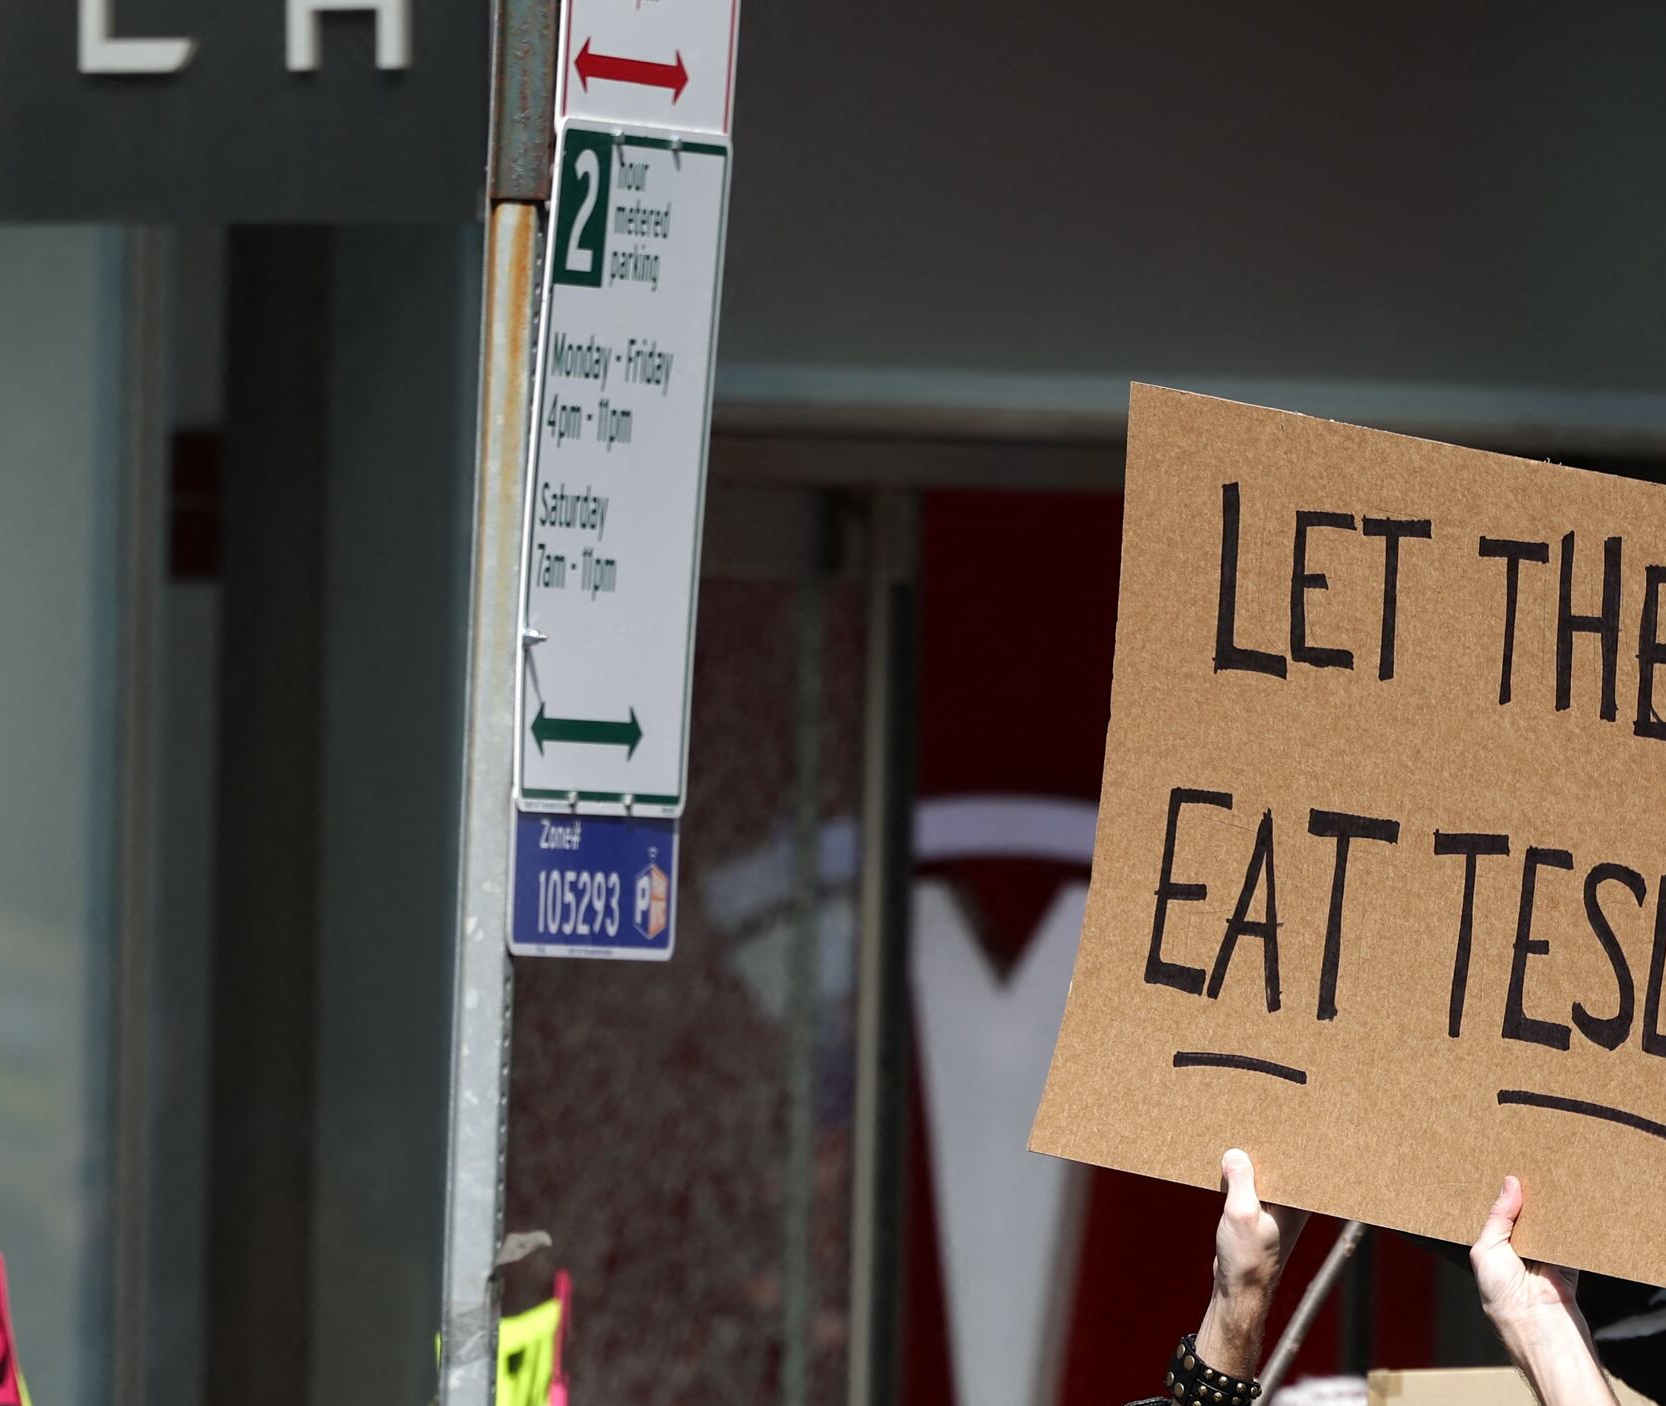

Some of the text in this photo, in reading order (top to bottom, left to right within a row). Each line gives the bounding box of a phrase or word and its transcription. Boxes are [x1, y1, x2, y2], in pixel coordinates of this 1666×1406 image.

[616, 158, 649, 192] hour
[564, 148, 601, 273] 2
[613, 199, 672, 239] metered
[609, 243, 661, 292] parking
[550, 331, 613, 392] Monday
[624, 337, 675, 398] Friday
[547, 393, 582, 449] 4pm
[596, 397, 632, 453] 11pm
[539, 481, 610, 542] Saturday
[536, 542, 566, 590] 7am
[581, 546, 617, 602] 11pm
[1212, 480, 1433, 682] LET
[539, 818, 582, 849] Zone#
[537, 868, 621, 938] 105293
[1142, 785, 1401, 1022] EAT
